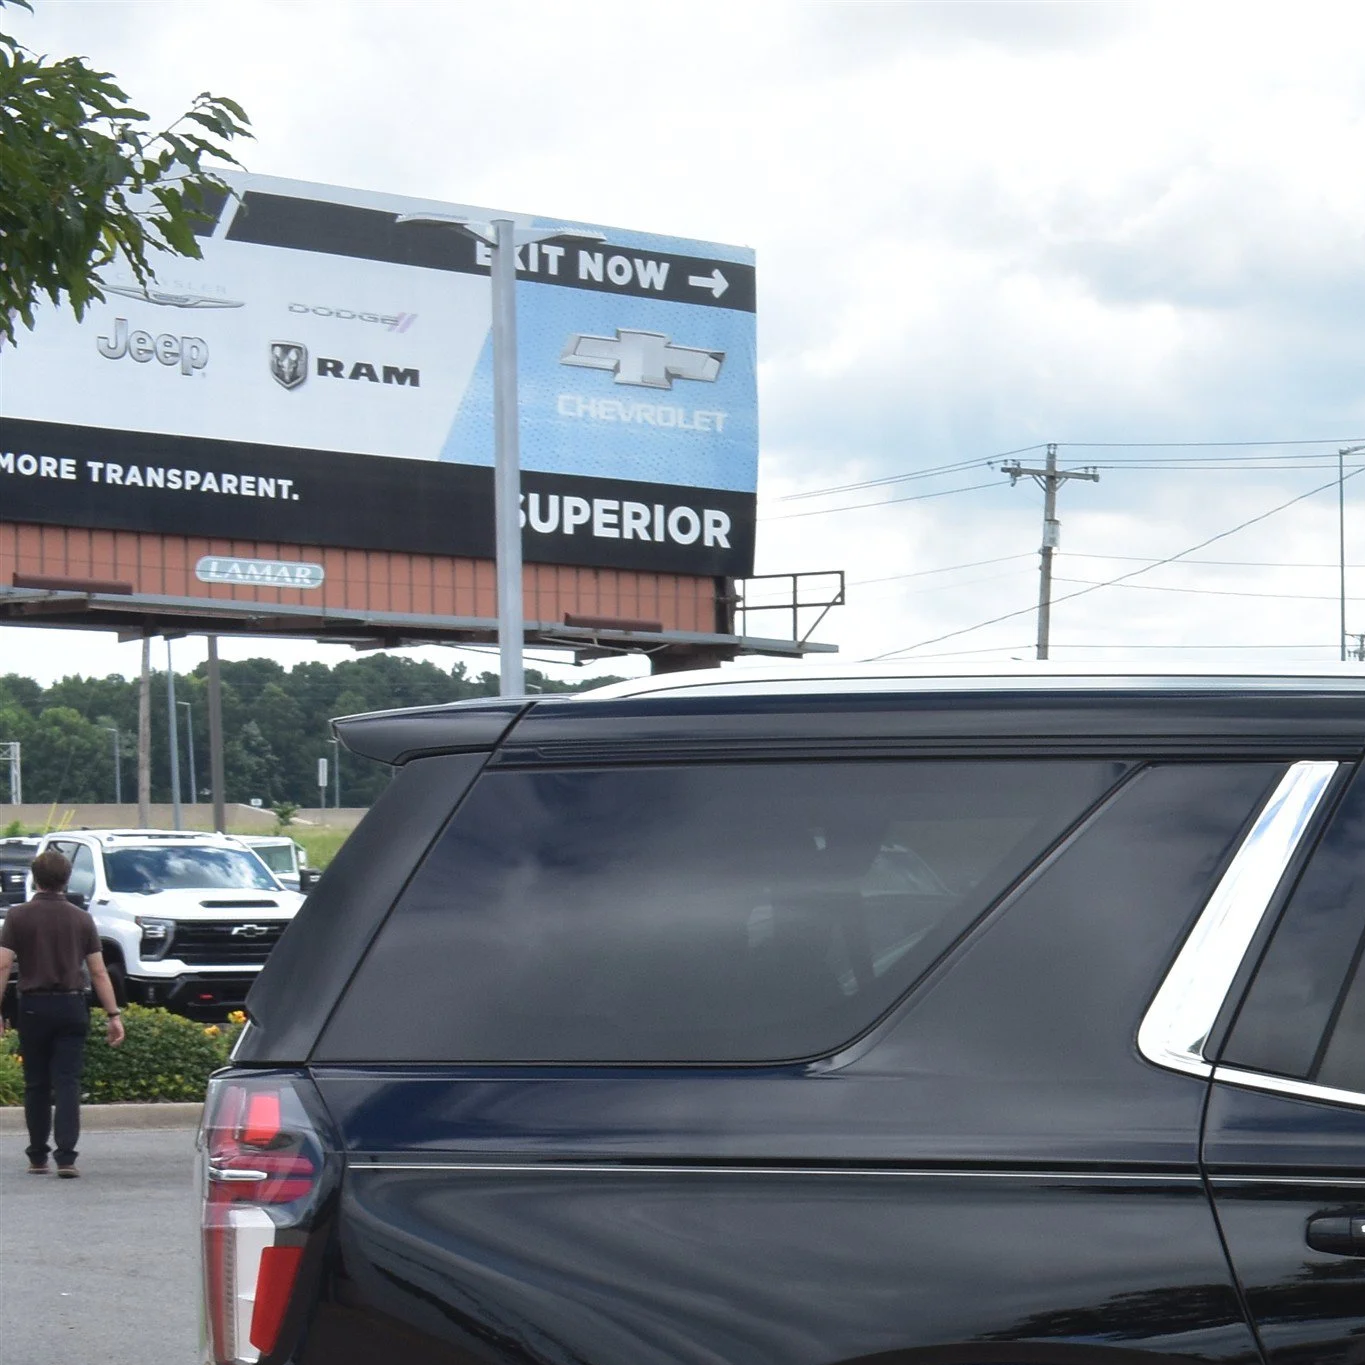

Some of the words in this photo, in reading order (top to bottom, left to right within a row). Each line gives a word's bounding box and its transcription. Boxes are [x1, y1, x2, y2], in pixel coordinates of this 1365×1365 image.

[578, 250, 669, 291] NOW
[288, 302, 401, 327] DODGE
[97, 317, 209, 376] Jeep
[317, 357, 420, 387] RAM
[557, 394, 728, 432] CHEVROLET
[0, 452, 77, 480] MORE
[87, 461, 300, 500] TRANSPARENT.
[520, 492, 731, 548] UPERIOR
[208, 559, 312, 585] LAMAR
